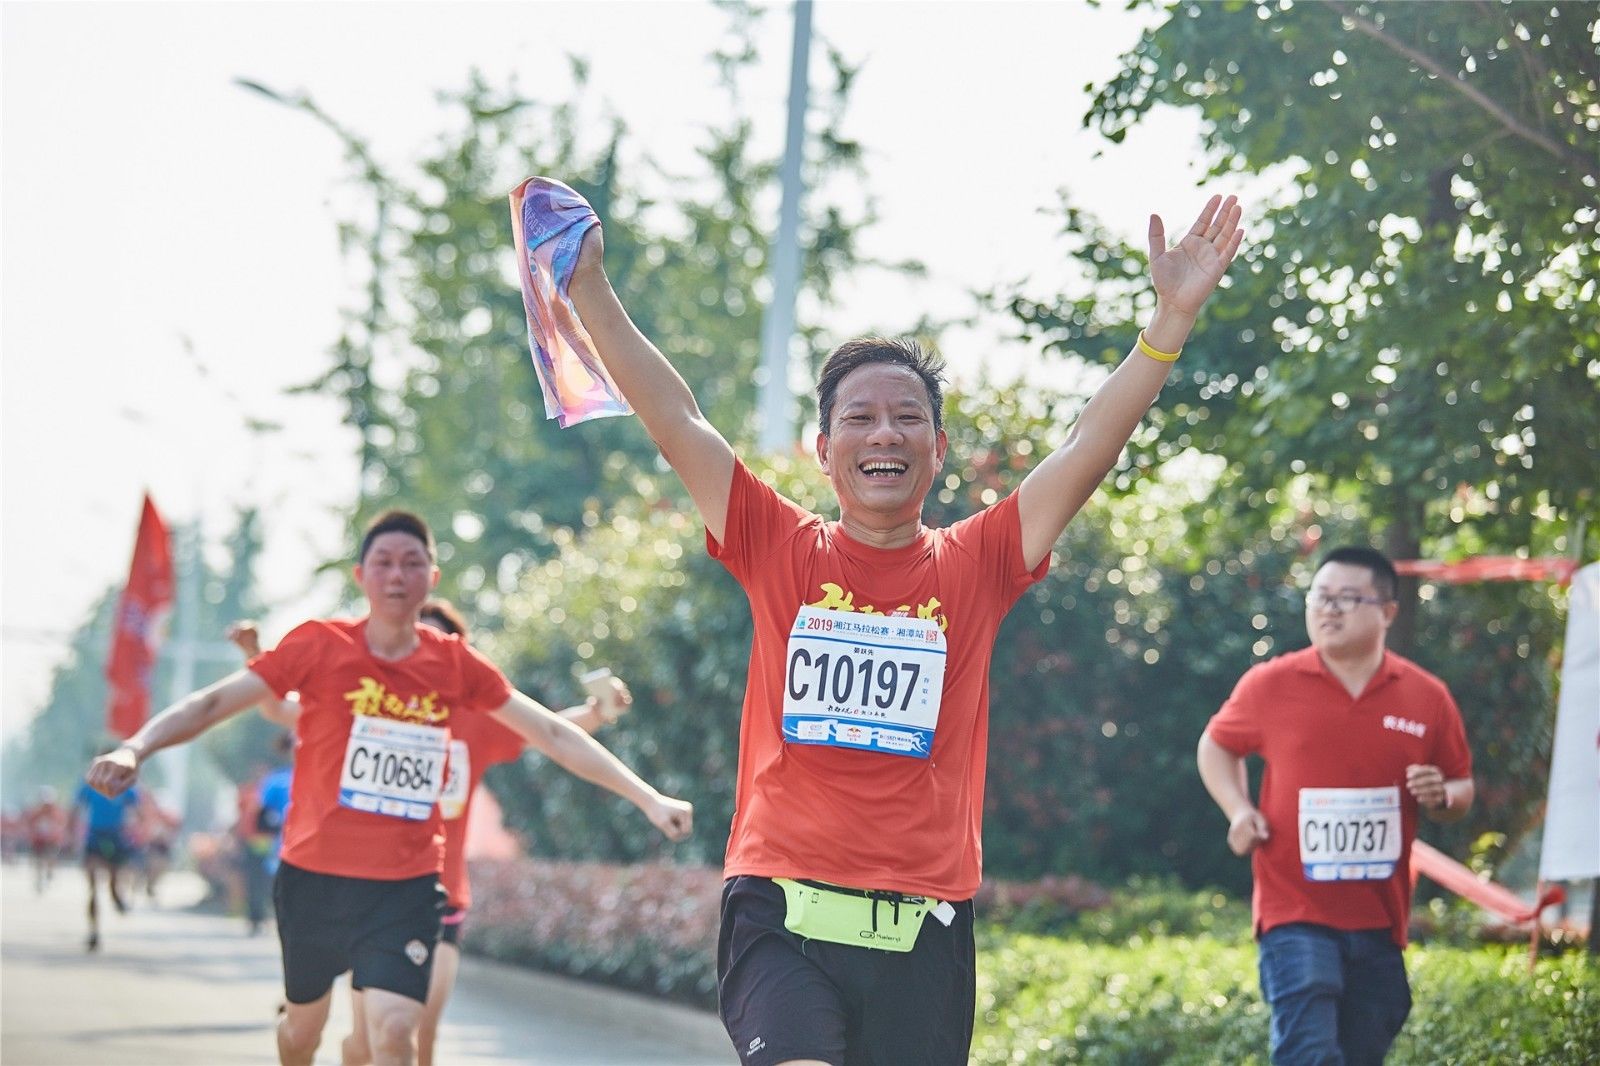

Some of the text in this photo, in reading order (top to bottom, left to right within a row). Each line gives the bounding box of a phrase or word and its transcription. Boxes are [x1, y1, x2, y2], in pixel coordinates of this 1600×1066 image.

[788, 648, 921, 712] C10197
[350, 746, 433, 790] C10684
[1303, 820, 1388, 853] C10737
